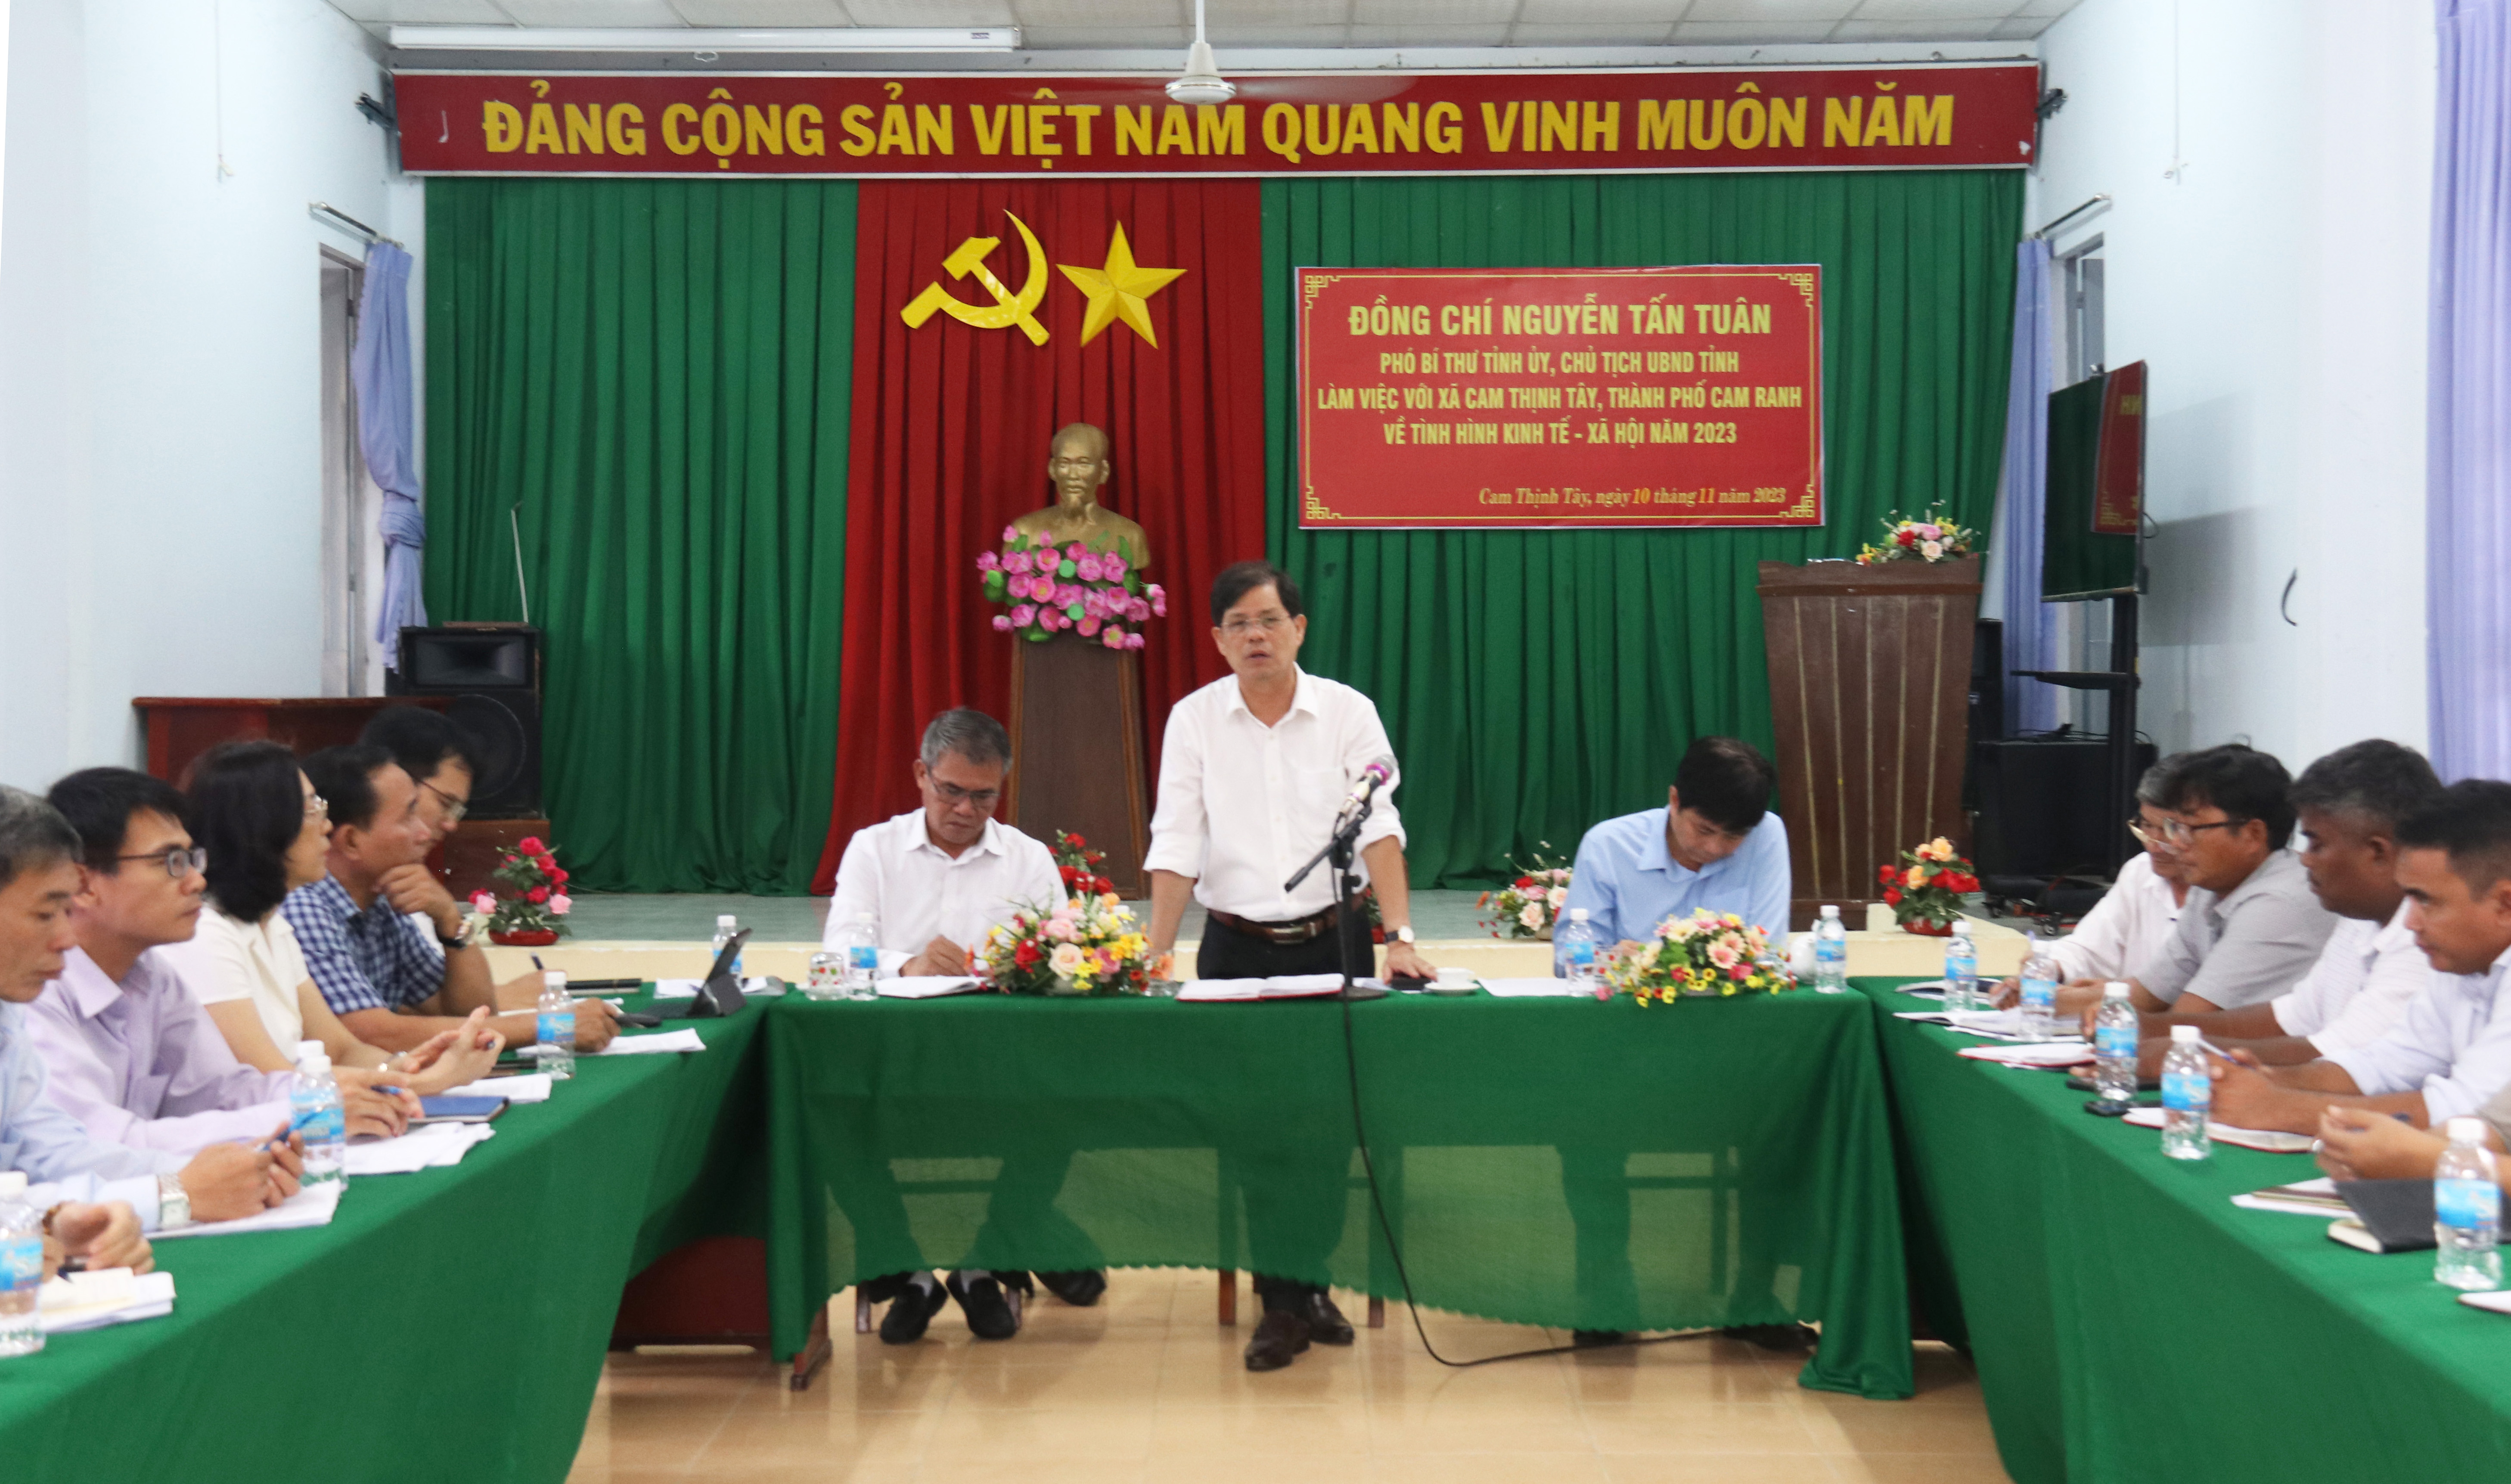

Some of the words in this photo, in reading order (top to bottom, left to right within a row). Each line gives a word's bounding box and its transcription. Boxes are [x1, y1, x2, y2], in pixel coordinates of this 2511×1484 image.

[483, 80, 645, 155] ĐẢNG
[663, 88, 824, 168] CỘNG
[840, 82, 953, 156] SẢN
[970, 88, 1101, 168] VIỆT
[1115, 105, 1245, 156] NAM
[1262, 102, 1462, 163] QUANG
[1481, 101, 1619, 152] VINH
[1639, 82, 1806, 149] MUÔN
[1824, 82, 1953, 147] NĂM
[1348, 295, 1431, 335] ĐỒNG
[1441, 298, 1493, 335] CHÍ
[1502, 292, 1619, 335] NGUYỄN
[1628, 293, 1684, 334] TẤN
[1694, 297, 1770, 334] TUÂN
[1380, 347, 1416, 374] PHÓ
[1421, 347, 1439, 373] BÍ
[1443, 350, 1480, 373] THƯ
[1482, 346, 1523, 373] TỈNH
[1528, 345, 1555, 376] ỦY,
[1560, 345, 1597, 373] CHỦ
[1601, 351, 1642, 378] TỊCH
[1647, 352, 1694, 373] UBND
[1699, 345, 1739, 372] TỈNH
[1318, 383, 1354, 409] LÀM
[1359, 383, 1399, 413] VIỆC
[1438, 383, 1461, 409] XÃ
[1465, 388, 1504, 409] CAM
[1508, 388, 1561, 413] THỊNH
[1566, 382, 1603, 411] TÂY,
[1607, 382, 1665, 408] THÀNH
[1670, 379, 1707, 408] PHỐ
[1711, 387, 1749, 408] CAM
[1755, 387, 1802, 407] RANH
[1383, 416, 1406, 444] VỀ
[1410, 418, 1450, 444] TÌNH
[1456, 418, 1498, 444] HÌNH
[1503, 423, 1544, 444] KINH
[1549, 415, 1571, 444] TẾ
[1587, 418, 1610, 443] XÃ
[1615, 418, 1645, 448] HỘI
[1650, 419, 1688, 443] NĂM
[1694, 422, 1737, 443] 2023
[1479, 488, 1512, 504] Cam
[1515, 488, 1559, 508] Thịnh
[1563, 488, 1592, 507] Tây,
[1595, 488, 1630, 507] ngày
[1633, 488, 1650, 504] 10
[1654, 487, 1696, 507] tháng
[1699, 487, 1715, 503] 11
[1718, 488, 1750, 503] năm
[1753, 487, 1787, 503] 2023
